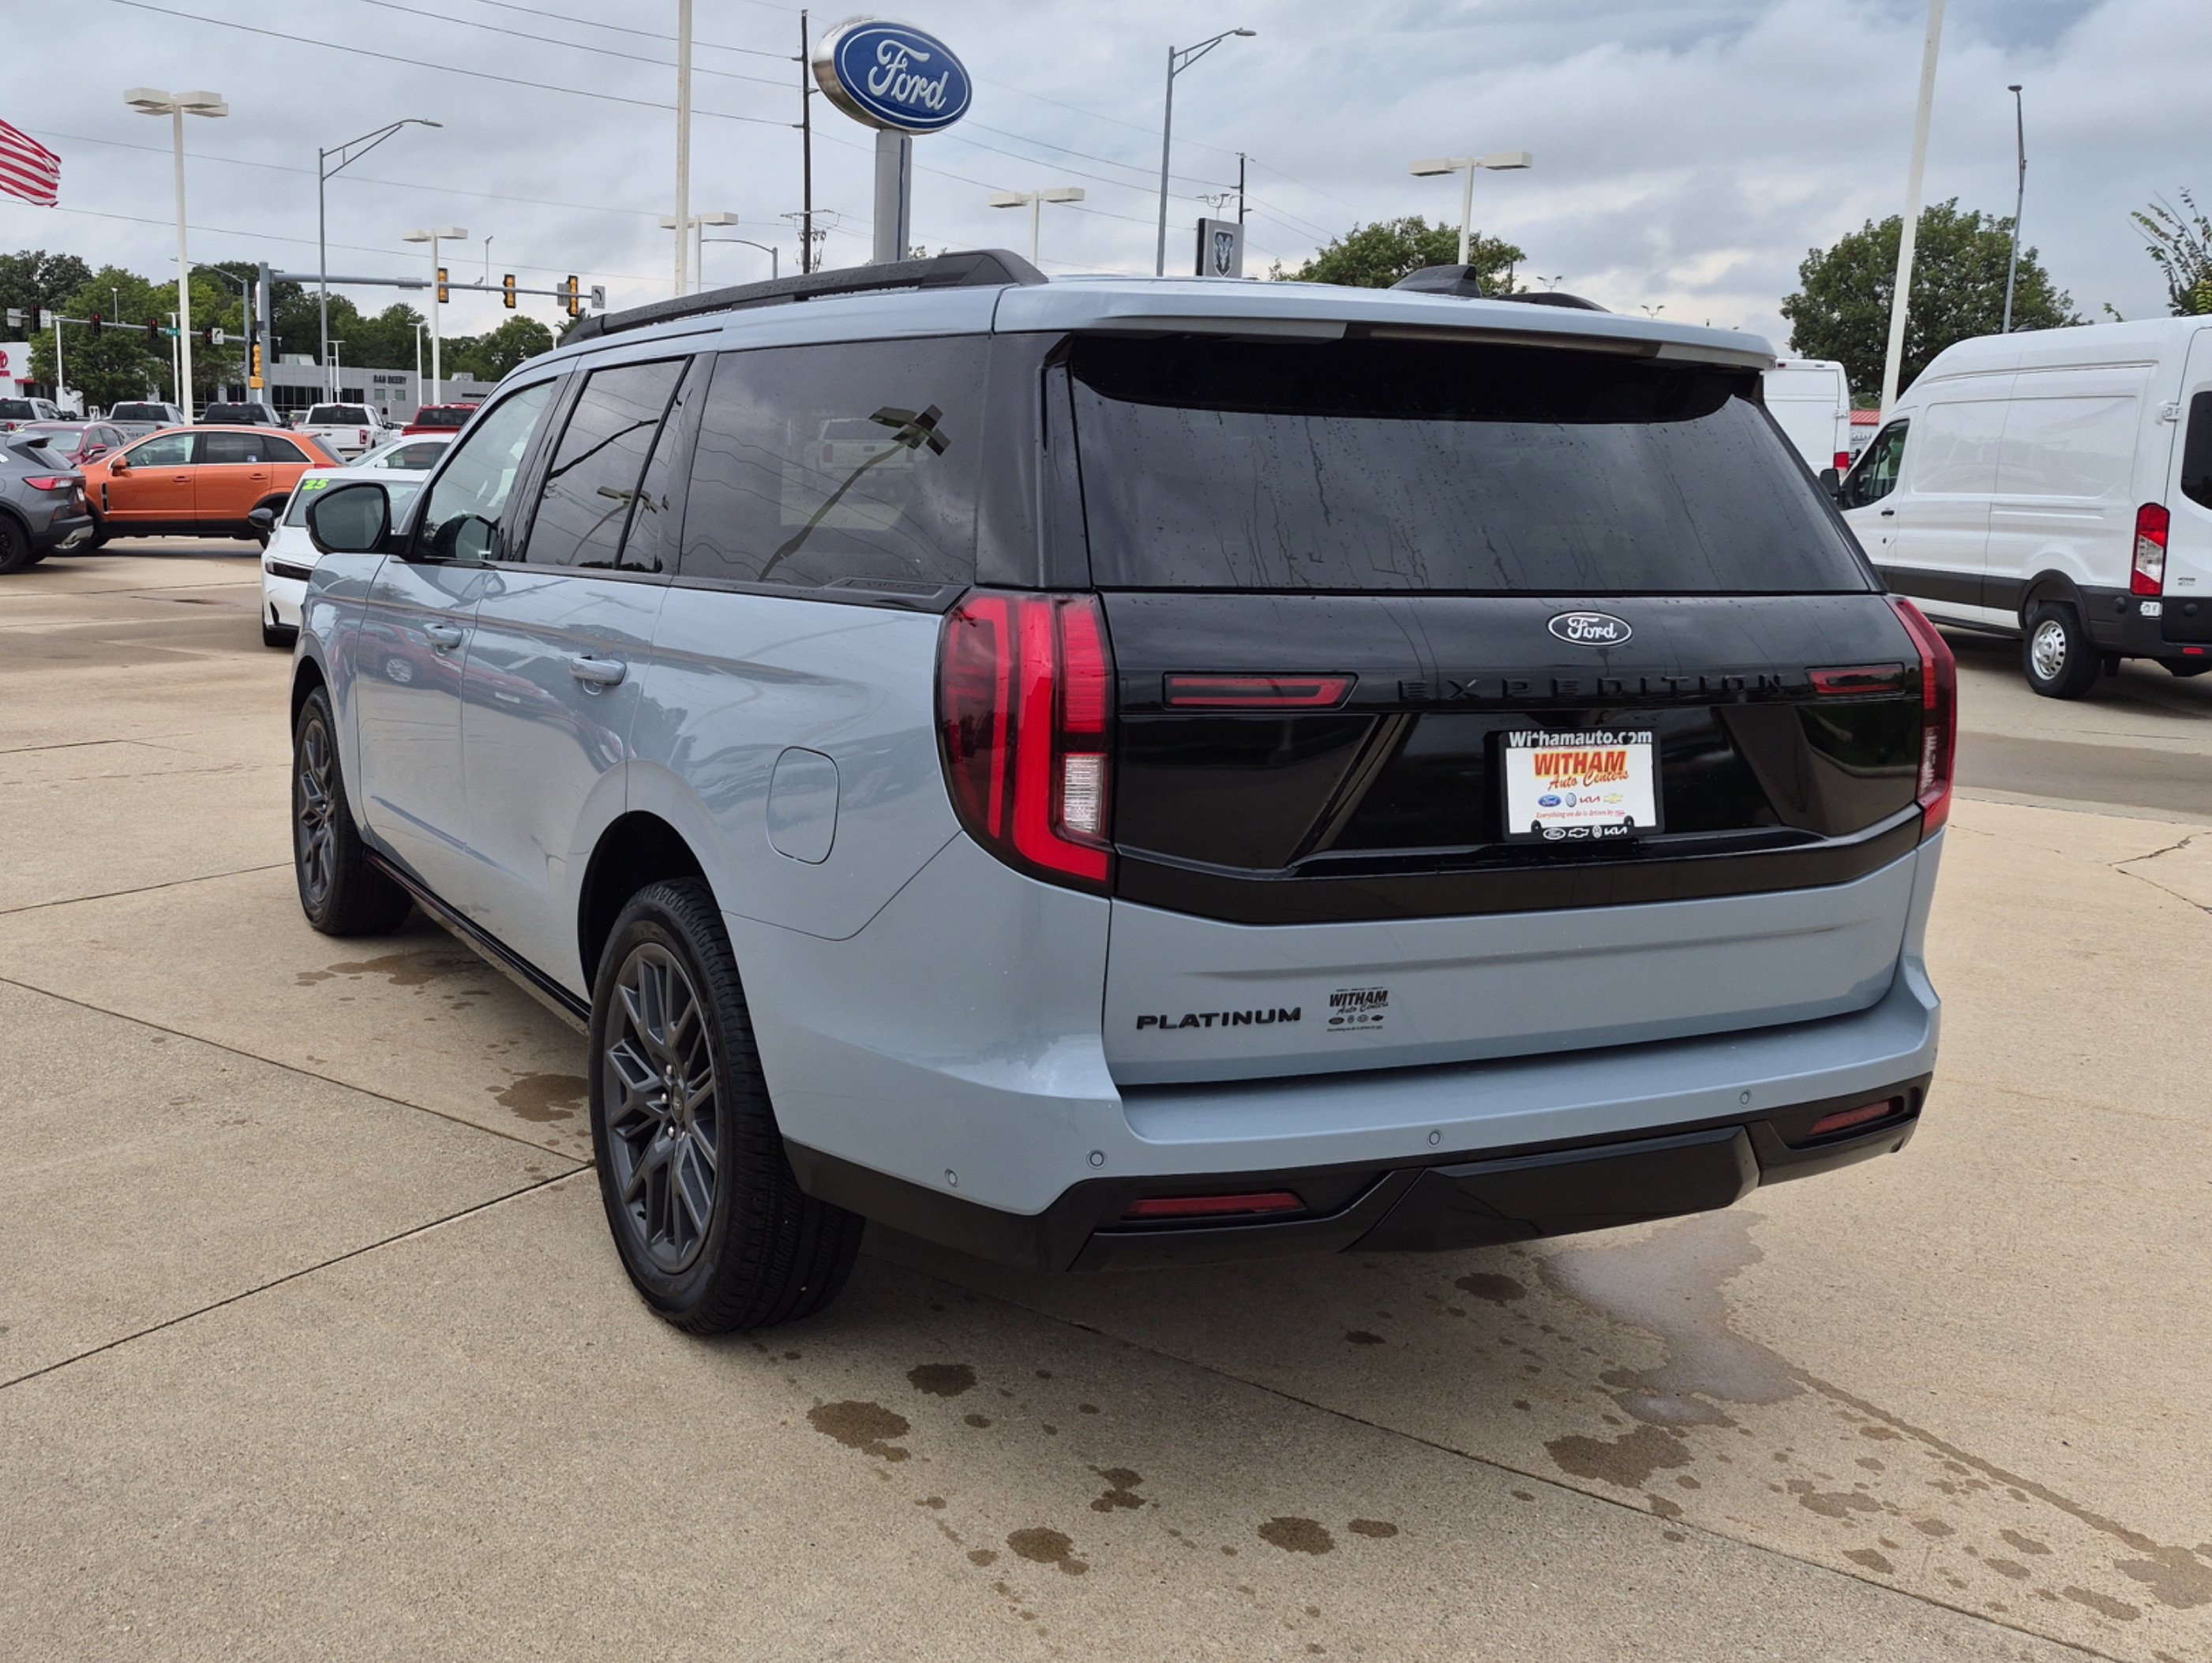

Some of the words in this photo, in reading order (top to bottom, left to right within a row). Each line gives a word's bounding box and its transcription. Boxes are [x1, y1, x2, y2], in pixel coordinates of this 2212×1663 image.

[868, 39, 949, 110] Ford
[302, 478, 329, 490] 25
[1567, 616, 1617, 639] Ford
[1398, 674, 1784, 701] EXPEDITION
[1534, 751, 1626, 776] WITHAM
[1548, 774, 1578, 790] Auto
[1583, 770, 1629, 787] Centers
[1329, 991, 1389, 1007] WITHAM
[1136, 1006, 1301, 1030] PLATINUM
